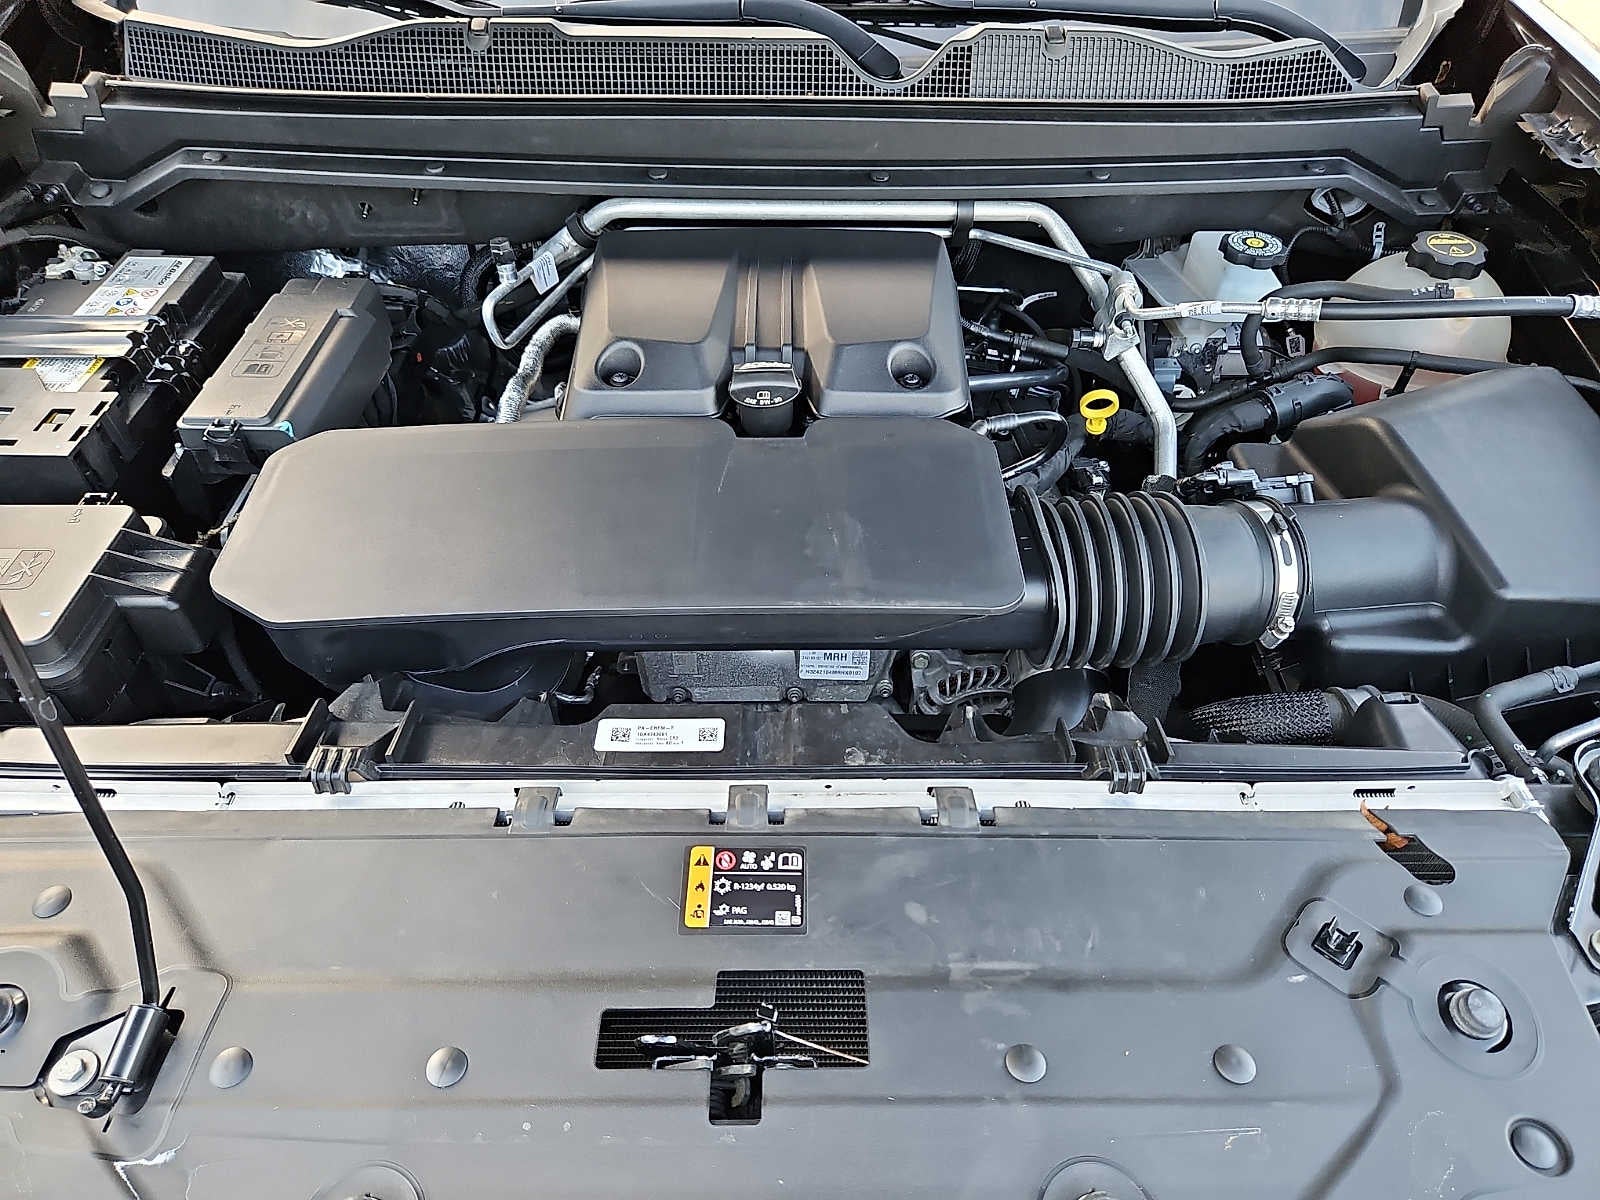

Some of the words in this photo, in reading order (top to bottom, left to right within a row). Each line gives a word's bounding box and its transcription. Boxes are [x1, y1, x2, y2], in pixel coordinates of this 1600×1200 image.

[823, 652, 848, 662] MRH
[733, 882, 765, 892] R-1234yf
[787, 883, 797, 893] kg
[731, 906, 748, 915] PAG
